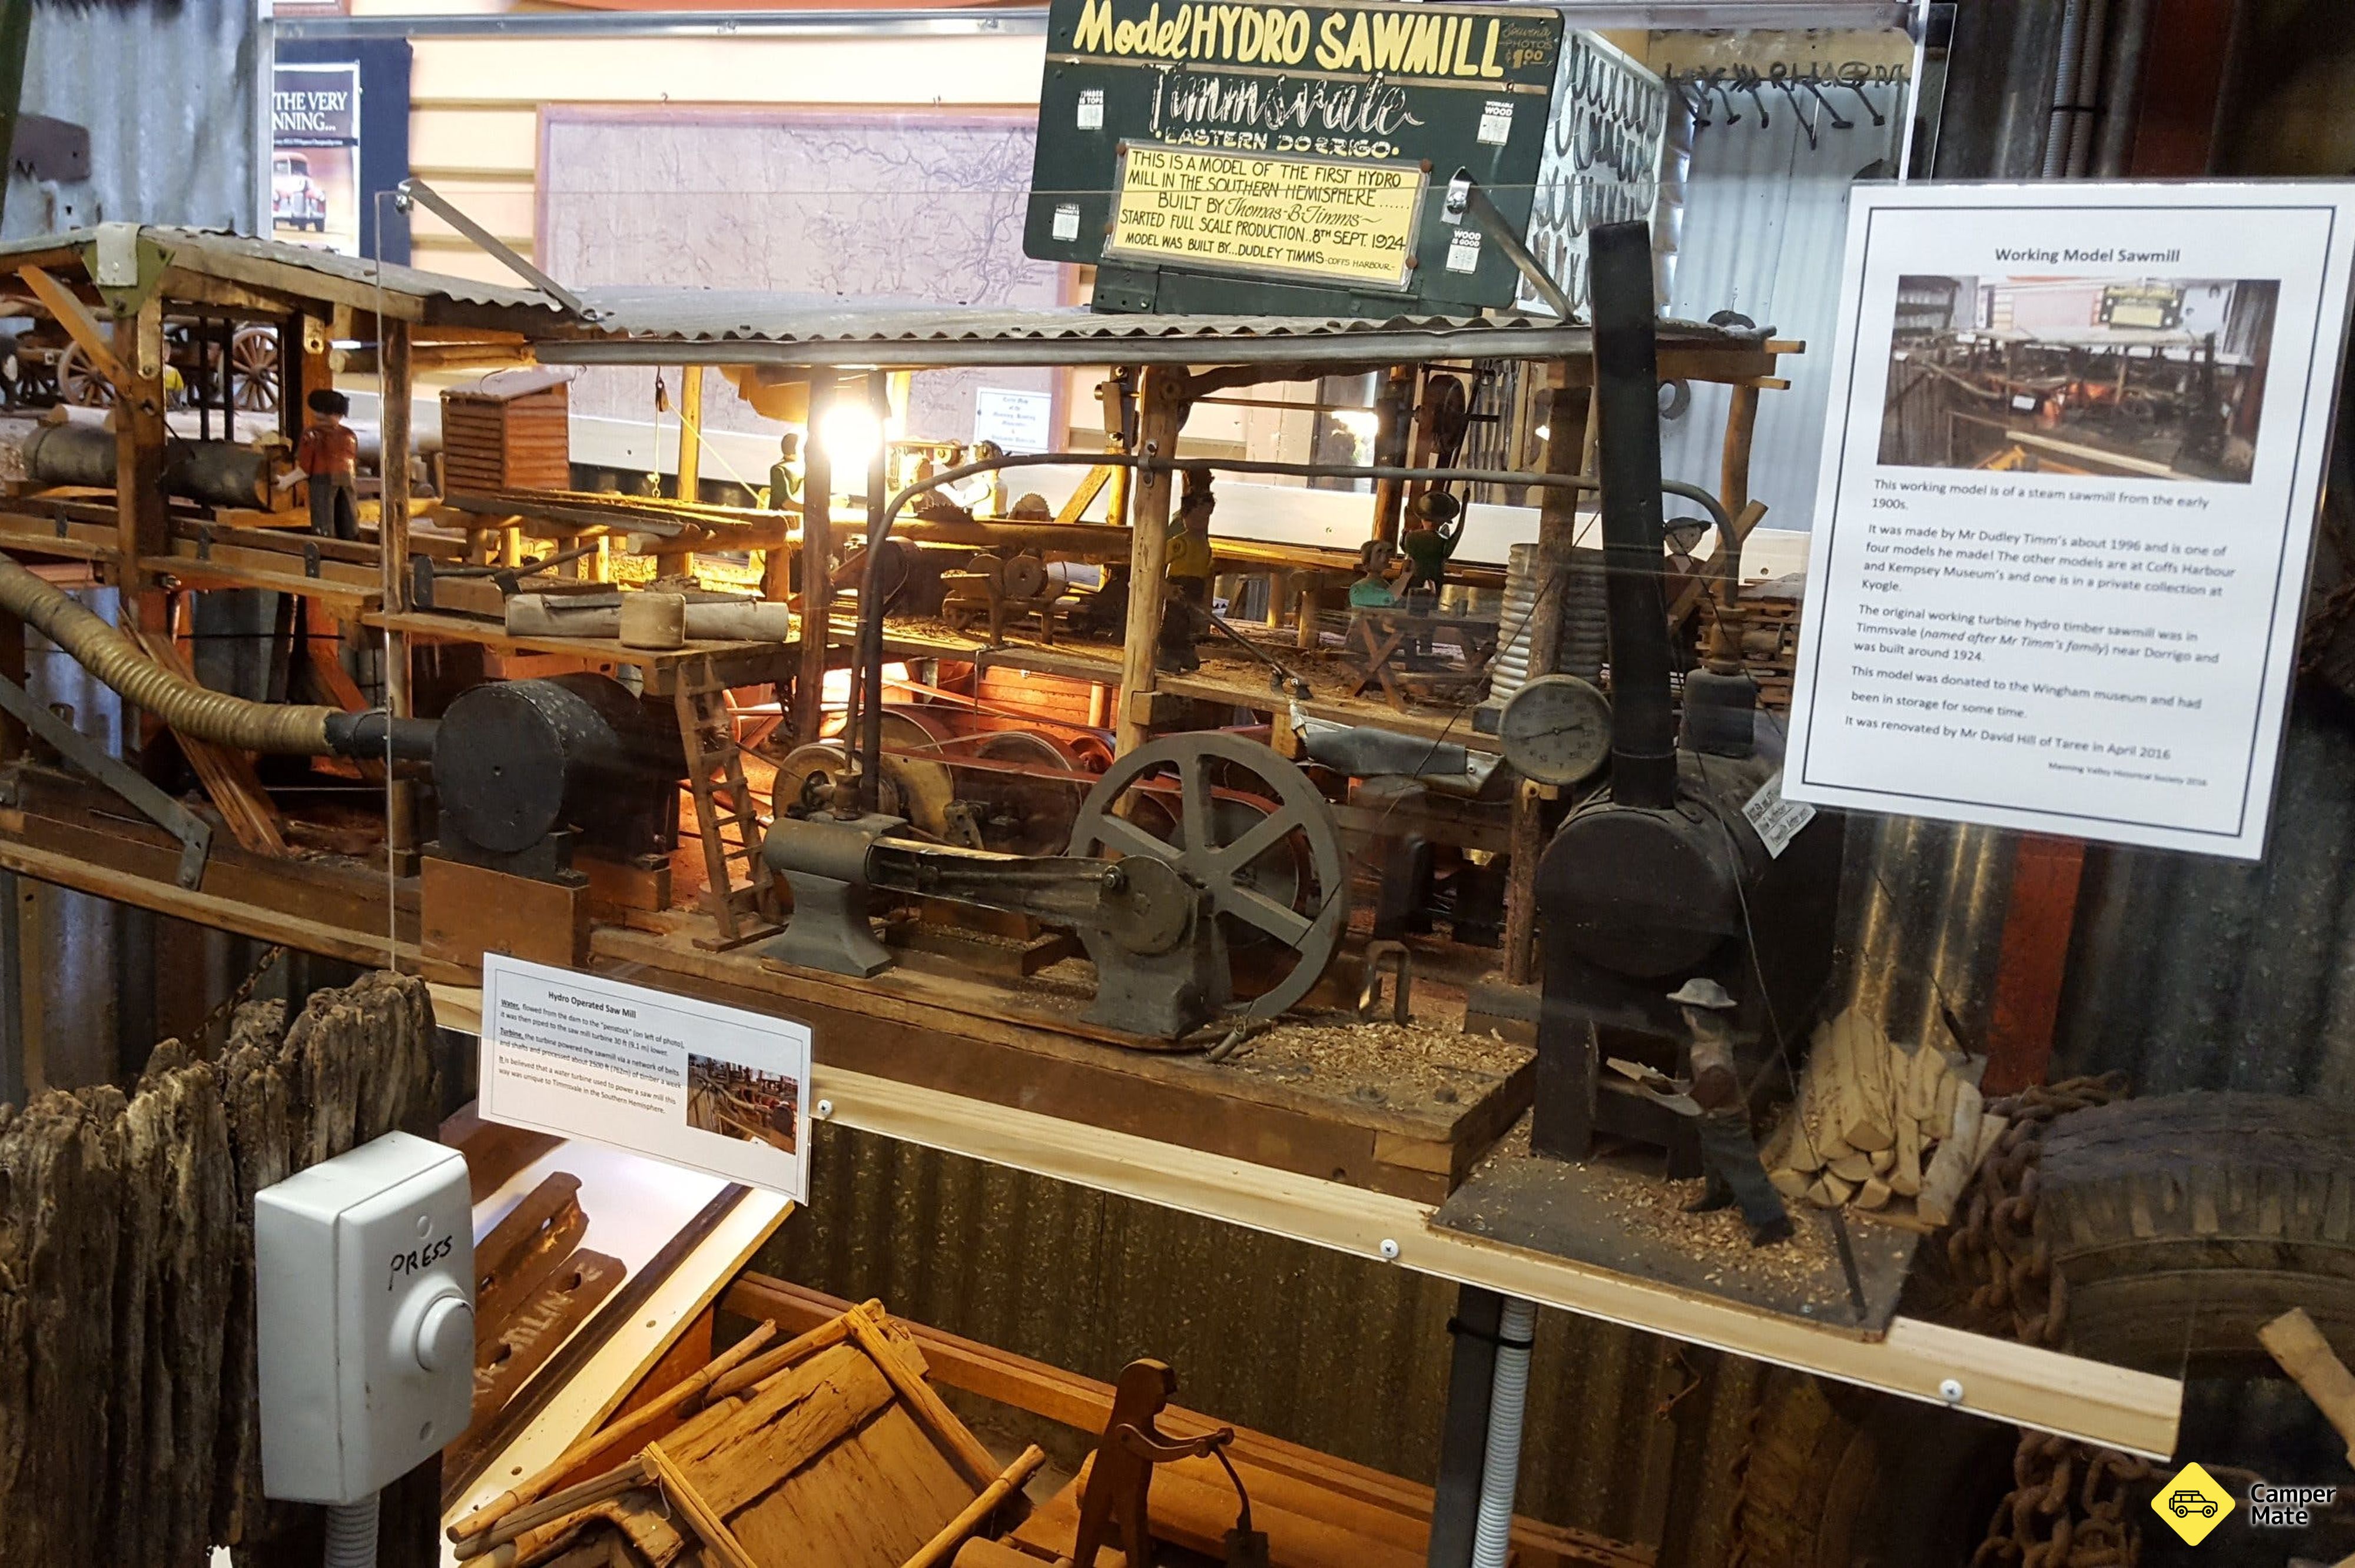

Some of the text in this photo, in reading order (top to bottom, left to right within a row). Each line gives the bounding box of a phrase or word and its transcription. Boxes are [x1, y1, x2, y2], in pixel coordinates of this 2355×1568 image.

[1073, 0, 1504, 77] Model HYDRO SAWMILL
[273, 91, 348, 111] THE VERY
[1485, 106, 1512, 117] WOOD
[1165, 127, 1268, 151] EASTERN
[1127, 170, 1158, 187] MILL
[1162, 172, 1175, 188] IN
[1180, 174, 1203, 191] THE
[1206, 177, 1279, 198] SOUTHERN
[1133, 151, 1401, 188] THIS IS A MODEL OF THE FIRST HYDRO
[1158, 192, 1202, 212] BUILT
[1207, 198, 1225, 214] BY
[1120, 209, 1165, 228] STARTED
[1170, 215, 1195, 231] FULL
[1199, 217, 1233, 234] SCALE
[1332, 230, 1368, 247] SEPT.
[1372, 234, 1406, 251] 1924
[1454, 230, 1481, 240] WOOD
[1459, 239, 1480, 247] GOOD
[1125, 232, 1159, 247] MODEL
[1162, 235, 1183, 250] WAS
[1188, 238, 1215, 253] BUILT
[1238, 244, 1283, 259] DUDLEY
[1286, 249, 1324, 264] TIMMS
[1995, 248, 2180, 263] Working Model Sawmill
[1874, 479, 2209, 510] This working model is of a steam sawmill from the early
[1868, 524, 1876, 533] It
[1879, 526, 1901, 535] was
[1905, 527, 1938, 537] made
[1941, 527, 1955, 541] by
[1958, 529, 1976, 539] Mr
[1978, 530, 2021, 545] Dudley
[2070, 537, 2107, 548] about
[2111, 539, 2141, 551] 1996
[2144, 542, 2168, 553] and
[2171, 544, 2180, 554] is
[2184, 546, 2208, 555] one
[2213, 546, 2227, 556] of
[1866, 541, 1890, 553] four
[1893, 545, 1935, 556] models
[1938, 547, 1953, 557] he
[1997, 550, 2019, 562] The
[2022, 553, 2055, 564] other
[2058, 556, 2103, 568] models
[2107, 560, 2127, 570] are
[2130, 562, 2142, 570] at
[2145, 561, 2177, 573] Coffs
[2181, 564, 2236, 577] Harbour
[1859, 603, 2197, 640] The original working turbine hydro timber sawmill was in
[1853, 643, 1875, 652] was
[1879, 642, 1904, 655] built
[1908, 647, 1949, 658] around
[1851, 665, 2202, 709] This model was donated to the Wingham museum and had
[1851, 690, 1879, 702] been
[1882, 694, 1893, 703] in
[1896, 697, 1939, 710] storage
[1942, 699, 1959, 710] for
[1962, 704, 1994, 715] some
[1845, 715, 2170, 759] It was renovated by Mr David Hill of Taree in April 2016
[548, 991, 636, 1018] Hydro Operated Saw Mill
[389, 1235, 452, 1291] PRESS
